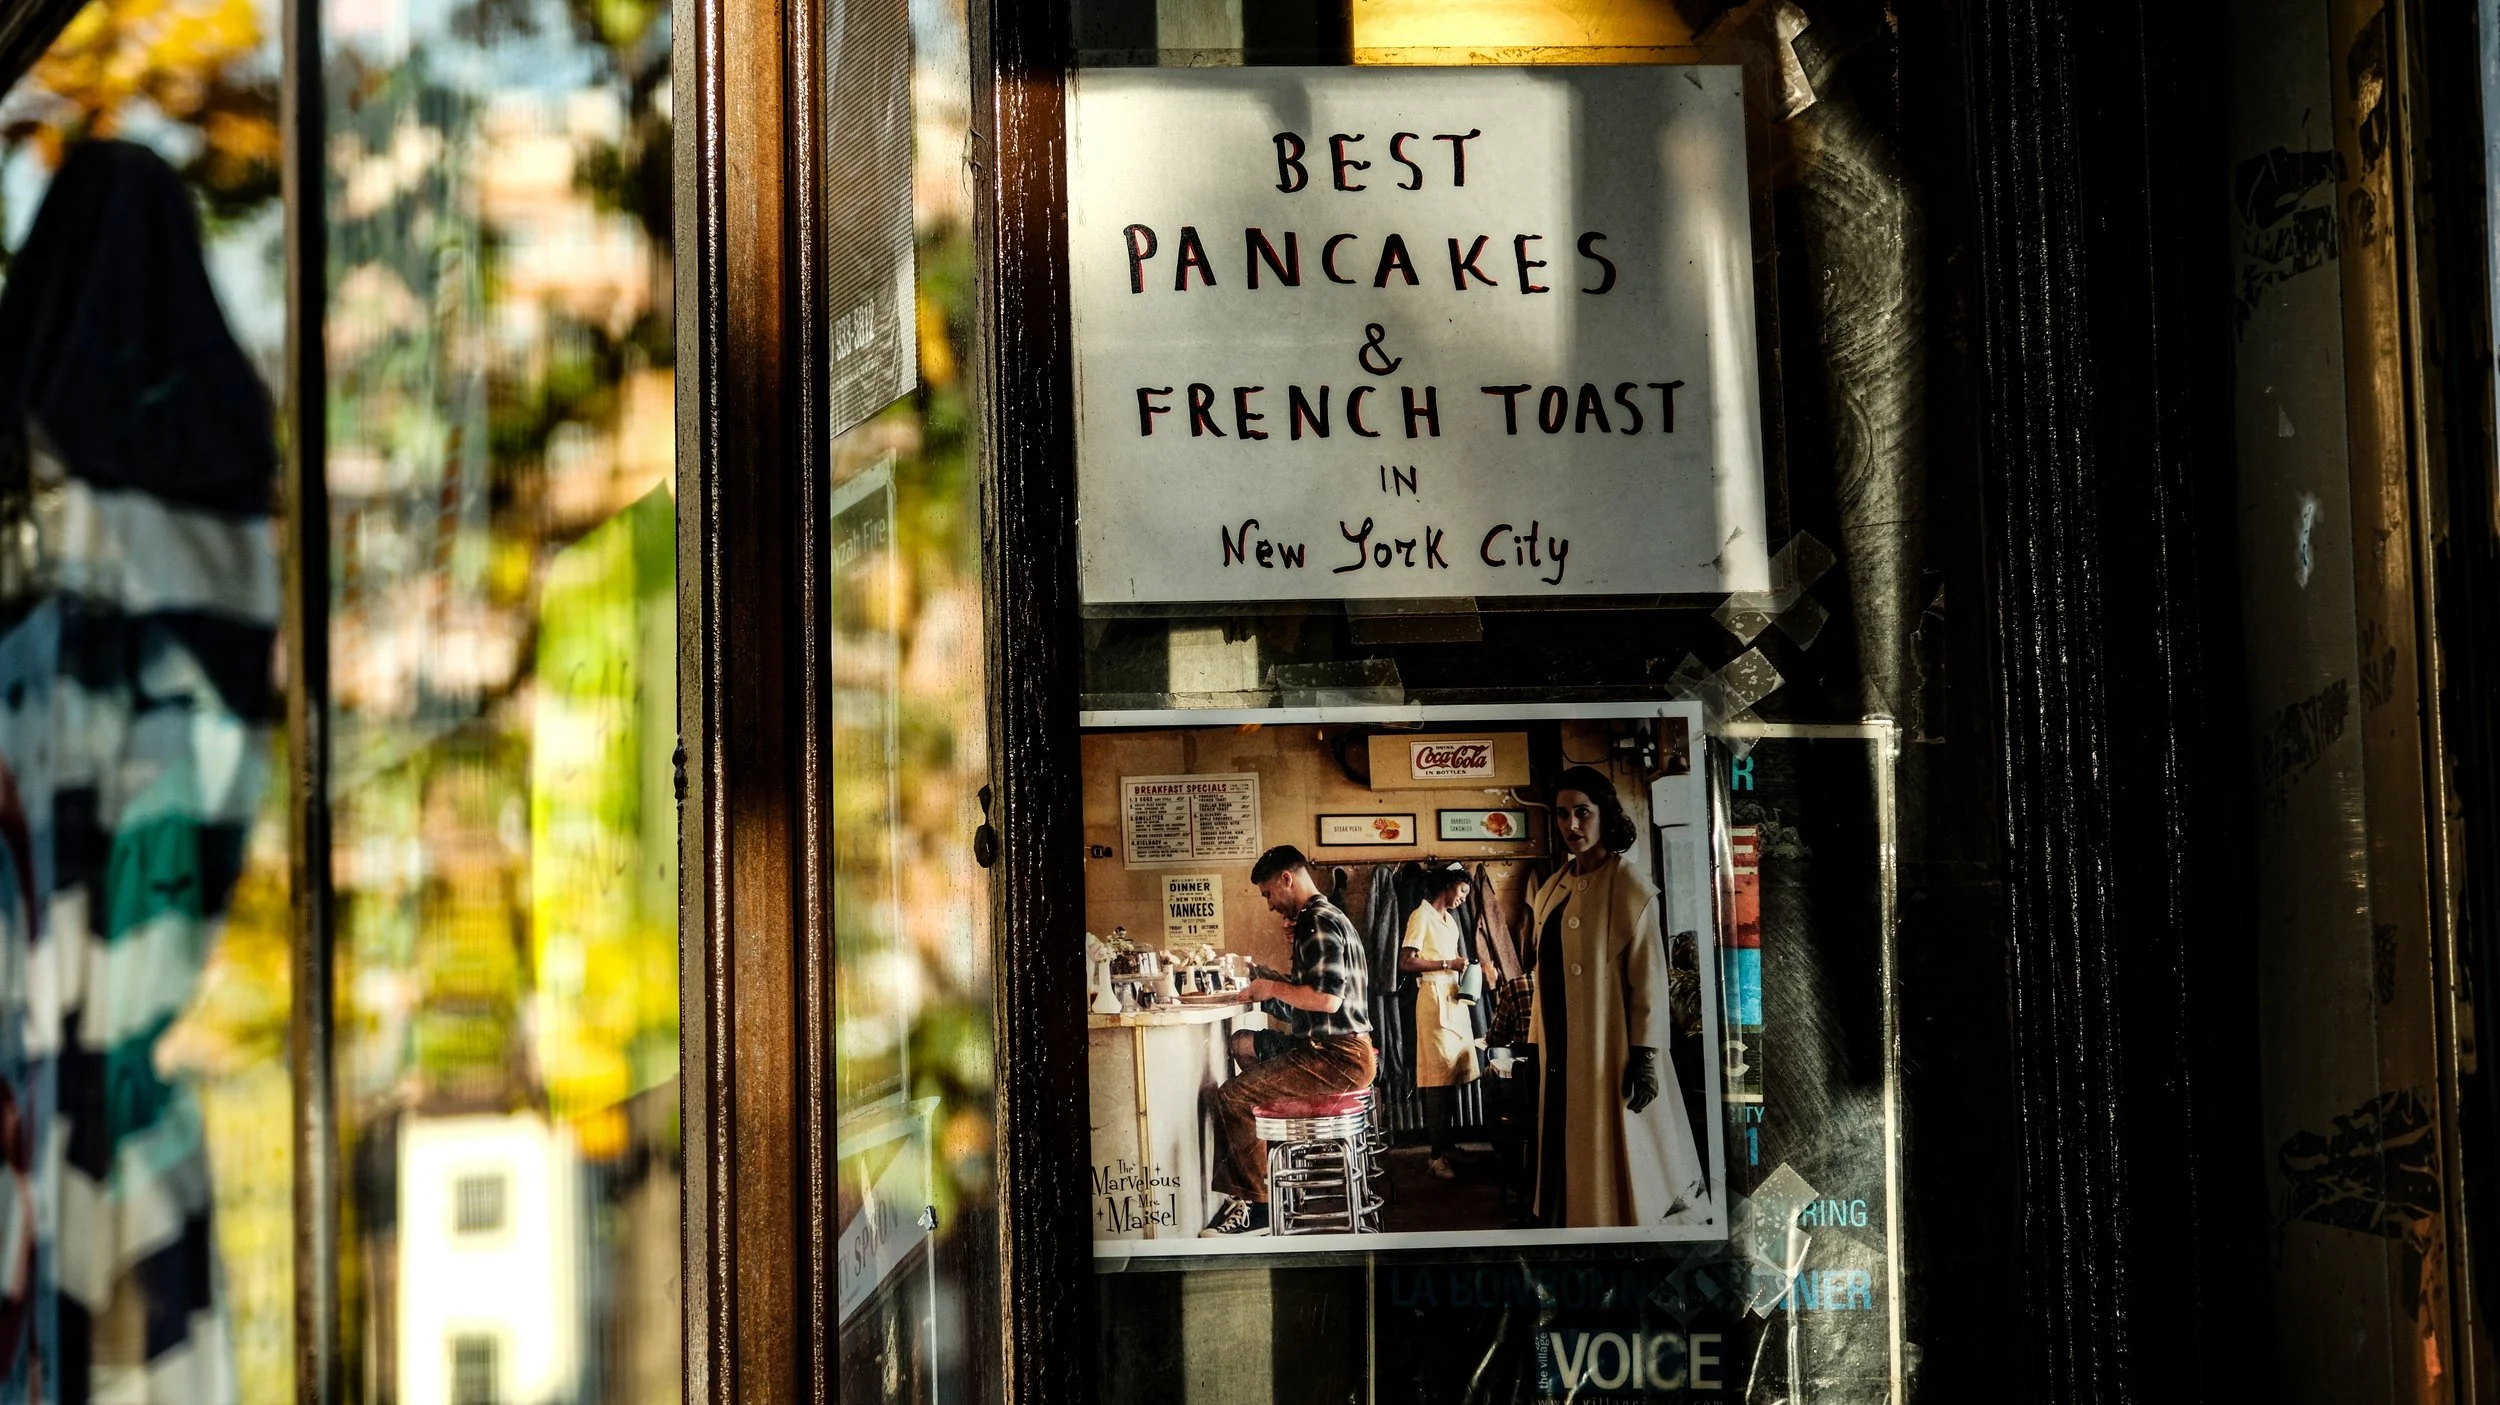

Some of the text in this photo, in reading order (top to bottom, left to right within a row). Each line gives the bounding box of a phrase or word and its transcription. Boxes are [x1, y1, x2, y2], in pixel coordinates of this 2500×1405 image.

[1272, 128, 1481, 193] BEST
[1123, 224, 1618, 295] PANCAKES
[1357, 323, 1402, 376] &
[1136, 380, 1686, 440] FRENCH TOAST
[1379, 464, 1419, 495] IN
[863, 519, 886, 553] Fire
[1222, 517, 1571, 585] New York City
[1415, 744, 1490, 770] Coca-Cola
[1135, 785, 1183, 794] BREAKFAST
[1187, 784, 1227, 793] SPECIALS
[1169, 882, 1210, 892] DINNER
[1169, 903, 1214, 918] YANKEES
[1188, 925, 1197, 934] 11
[1090, 1165, 1181, 1197] Marvelous
[1116, 1159, 1134, 1174] The
[1105, 1193, 1178, 1234] Maisel
[1537, 1331, 1551, 1369] village
[1549, 1331, 1723, 1391] VOICE
